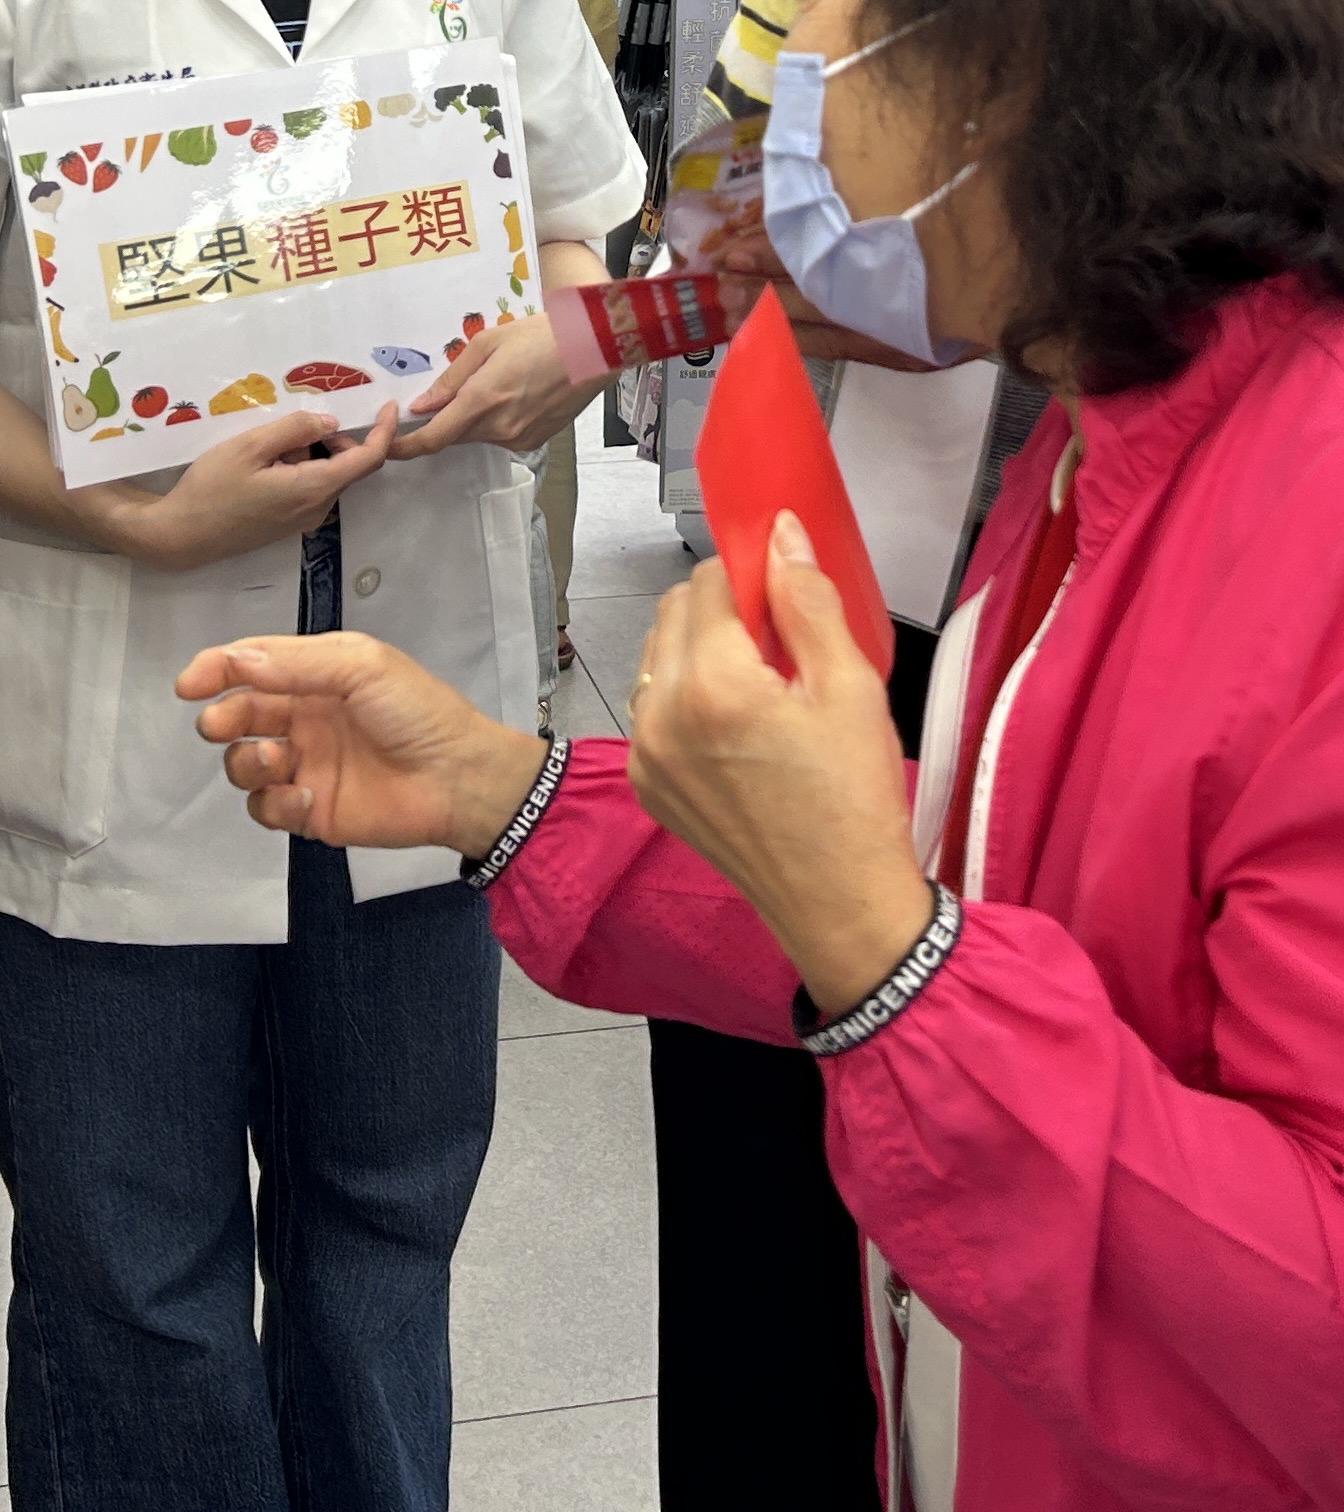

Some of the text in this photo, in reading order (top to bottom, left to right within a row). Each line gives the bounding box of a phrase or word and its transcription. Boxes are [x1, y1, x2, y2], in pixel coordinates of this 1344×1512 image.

[115, 185, 473, 310] 堅果種子類
